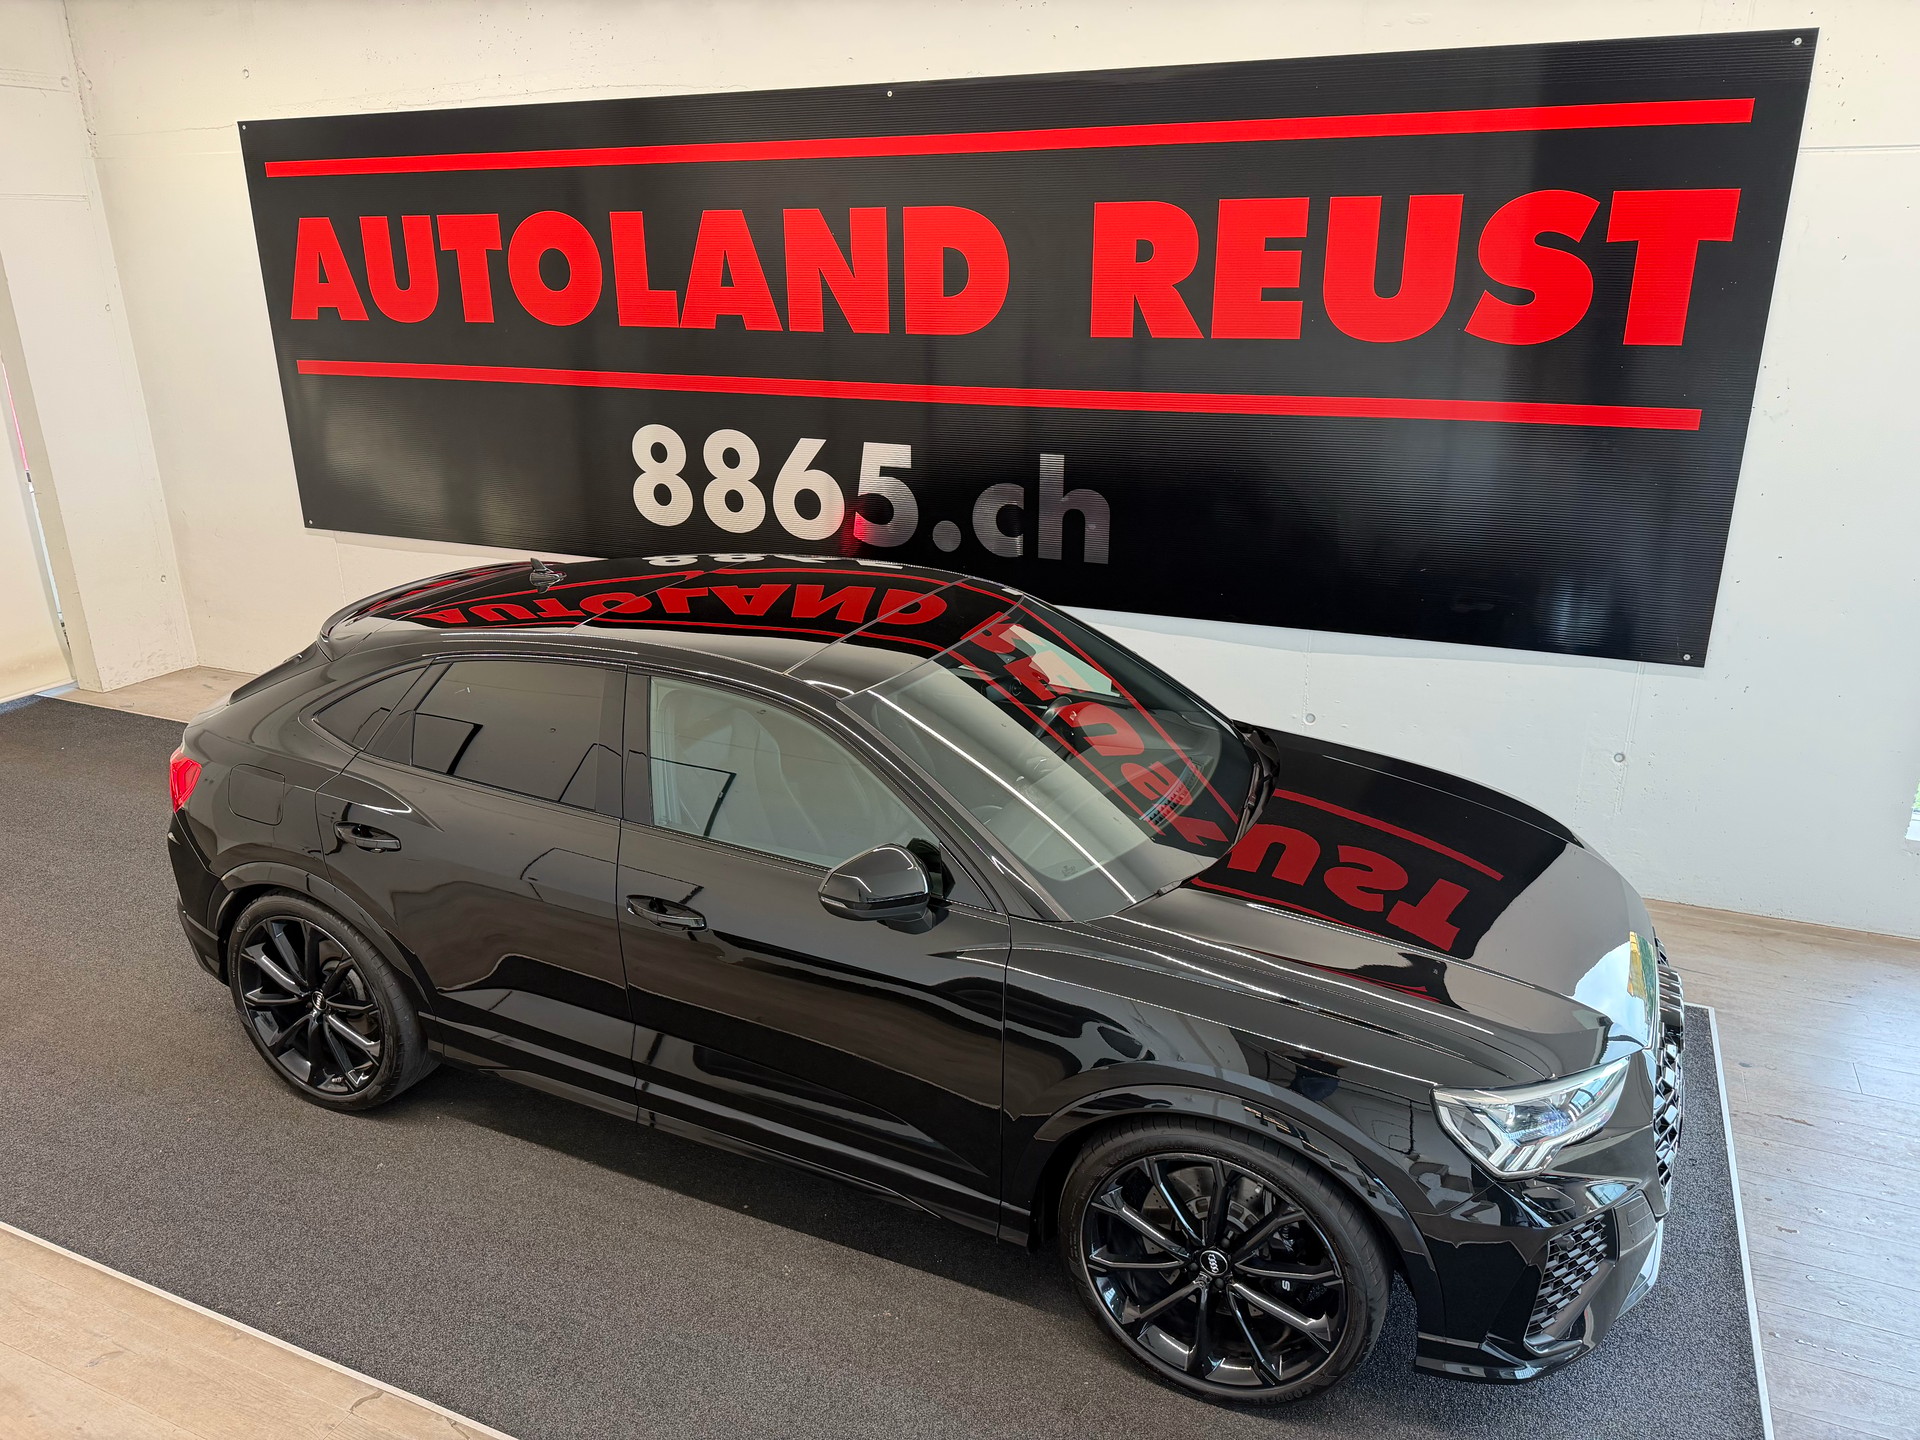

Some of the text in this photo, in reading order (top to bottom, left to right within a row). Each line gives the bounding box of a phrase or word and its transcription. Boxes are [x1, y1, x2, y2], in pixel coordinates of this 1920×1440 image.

[290, 187, 1743, 347] AUTOLAND REUST
[631, 423, 1111, 565] 8865.ch
